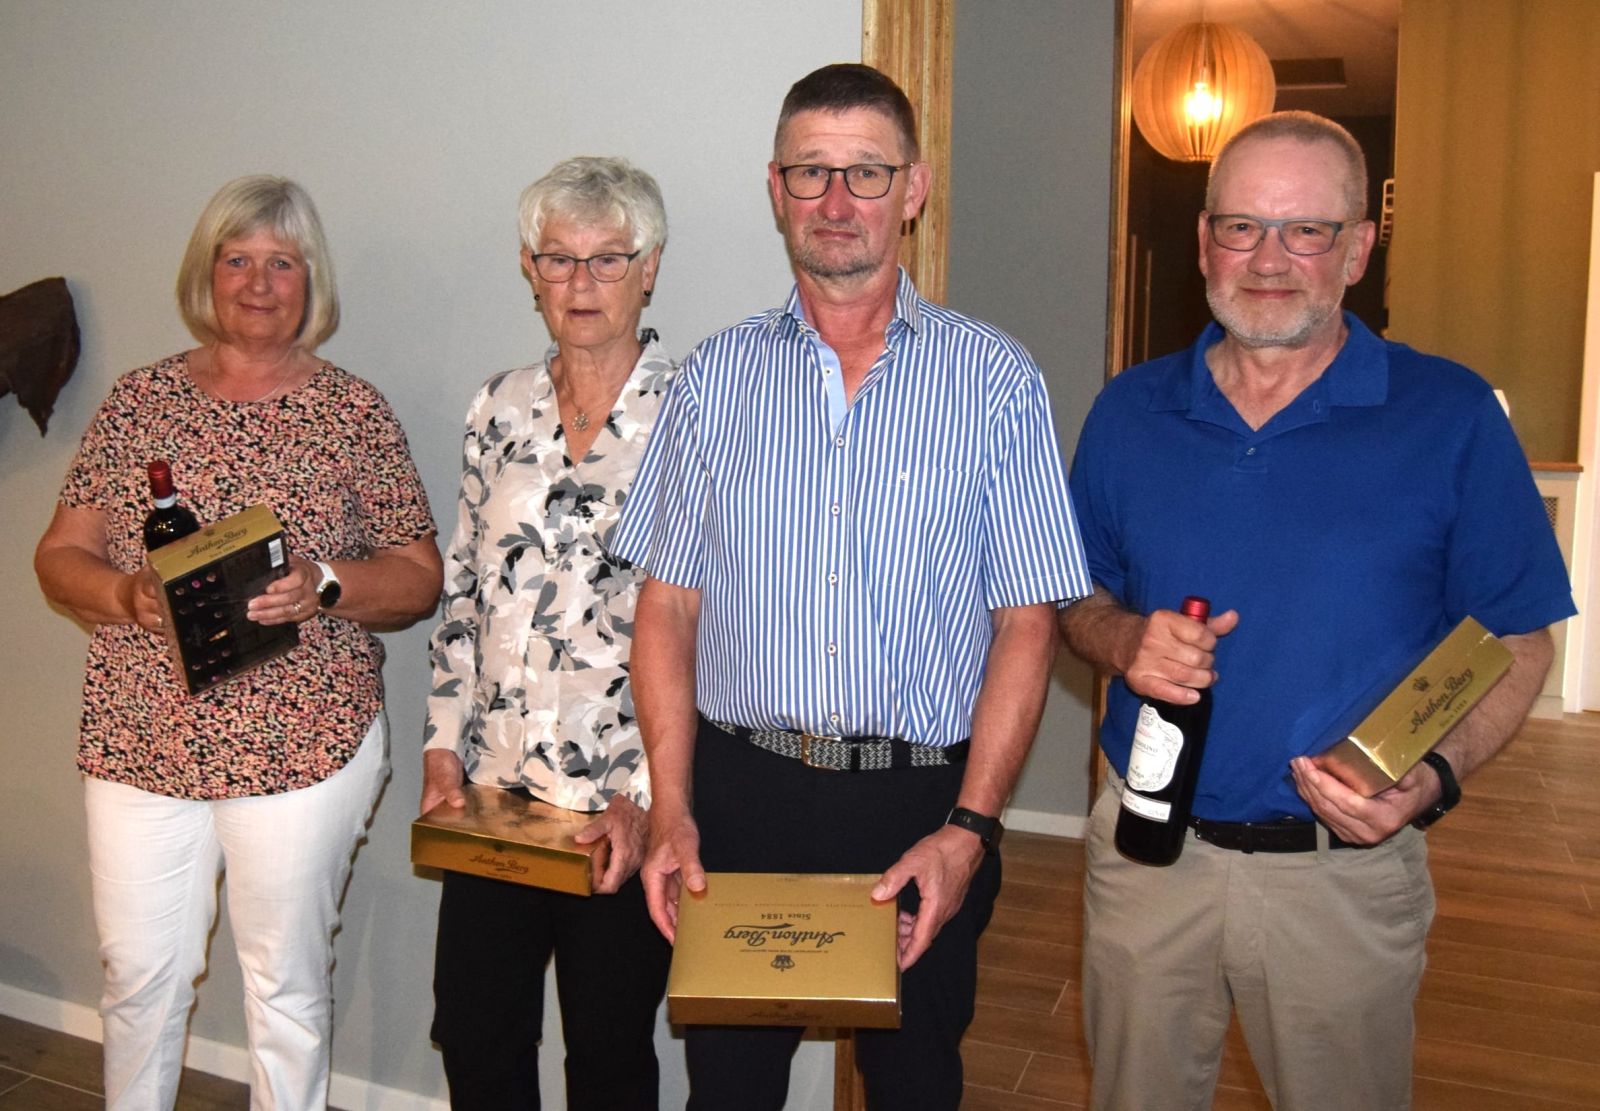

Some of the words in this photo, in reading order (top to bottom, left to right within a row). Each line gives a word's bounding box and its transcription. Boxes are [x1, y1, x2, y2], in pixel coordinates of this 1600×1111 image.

[1410, 694, 1447, 734] Anthon
[1443, 668, 1474, 698] Berg
[724, 924, 768, 947] Berg
[771, 930, 846, 949] Anthon
